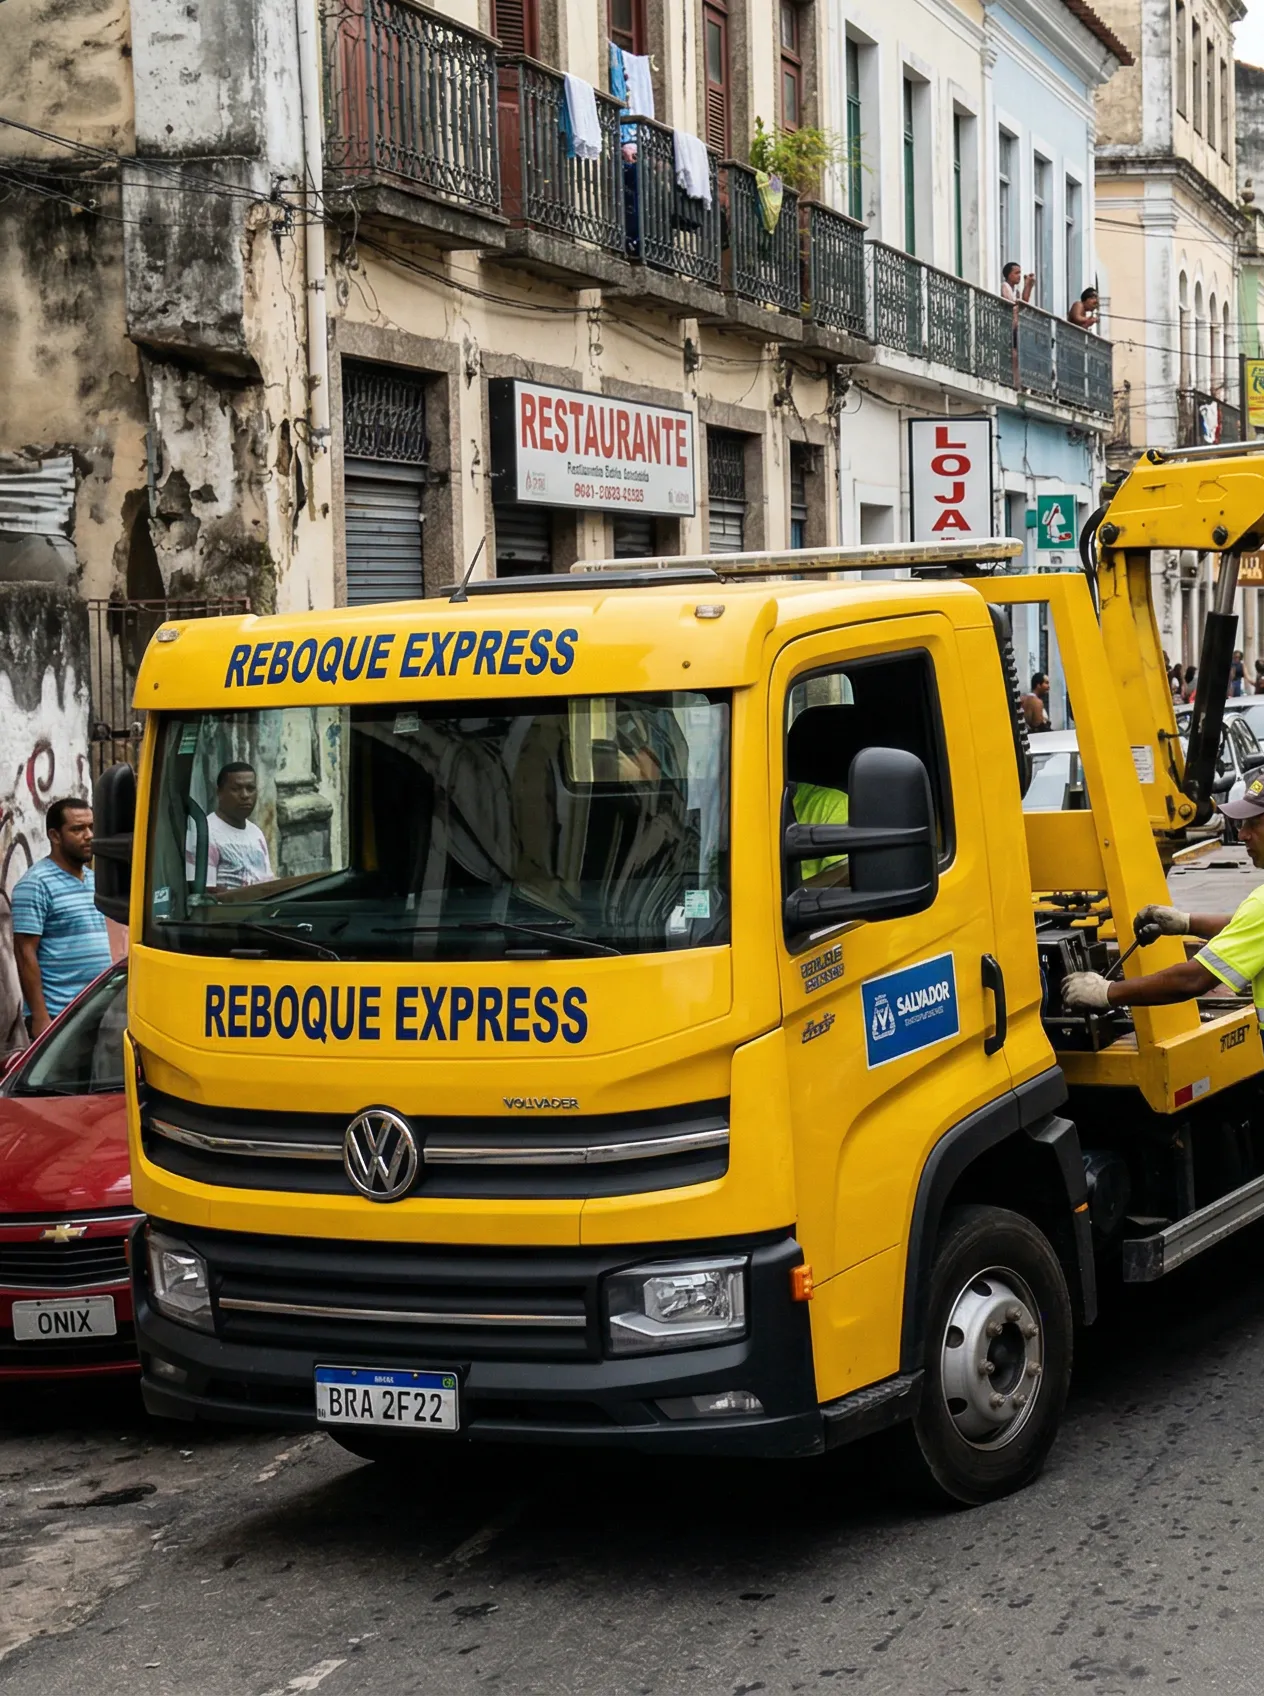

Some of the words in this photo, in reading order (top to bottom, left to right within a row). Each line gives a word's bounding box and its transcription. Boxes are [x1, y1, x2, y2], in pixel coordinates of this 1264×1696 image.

[520, 392, 688, 468] RESTAURANTE
[930, 426, 972, 532] LOJA
[223, 633, 397, 689] REBOQUE
[398, 628, 579, 679] EXPRESS
[204, 984, 382, 1044] REBOQUE
[395, 986, 589, 1044] EXPRESS
[896, 980, 951, 1017] SALVADOR
[37, 1309, 93, 1335] ONIX
[328, 1386, 375, 1419] BRA
[382, 1389, 443, 1423] 2F22
